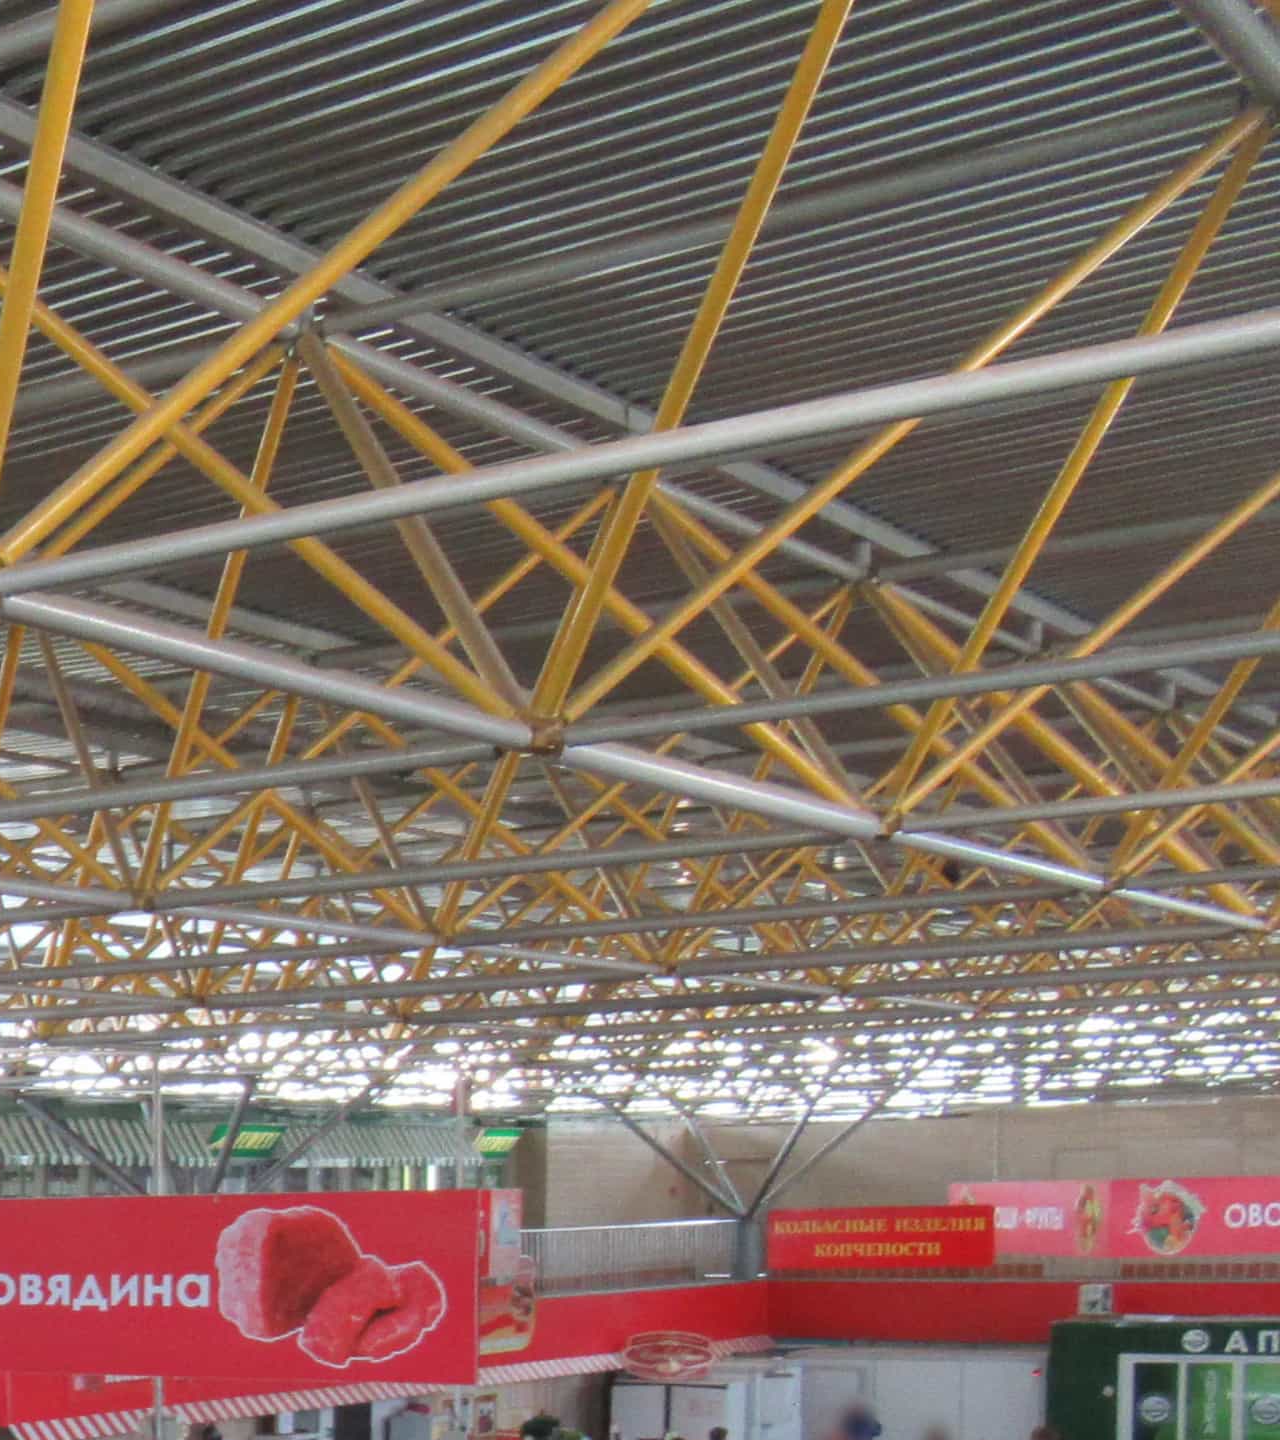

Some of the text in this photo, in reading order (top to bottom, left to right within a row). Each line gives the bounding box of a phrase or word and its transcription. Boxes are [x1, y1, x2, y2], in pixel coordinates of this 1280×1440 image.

[773, 1217, 889, 1235] КОЛБАСНЫЕ
[894, 1215, 987, 1233] ИЗДЕЛИЯ
[813, 1241, 943, 1257] КОПЧЕНОСТИ
[1223, 1329, 1280, 1353] АП
